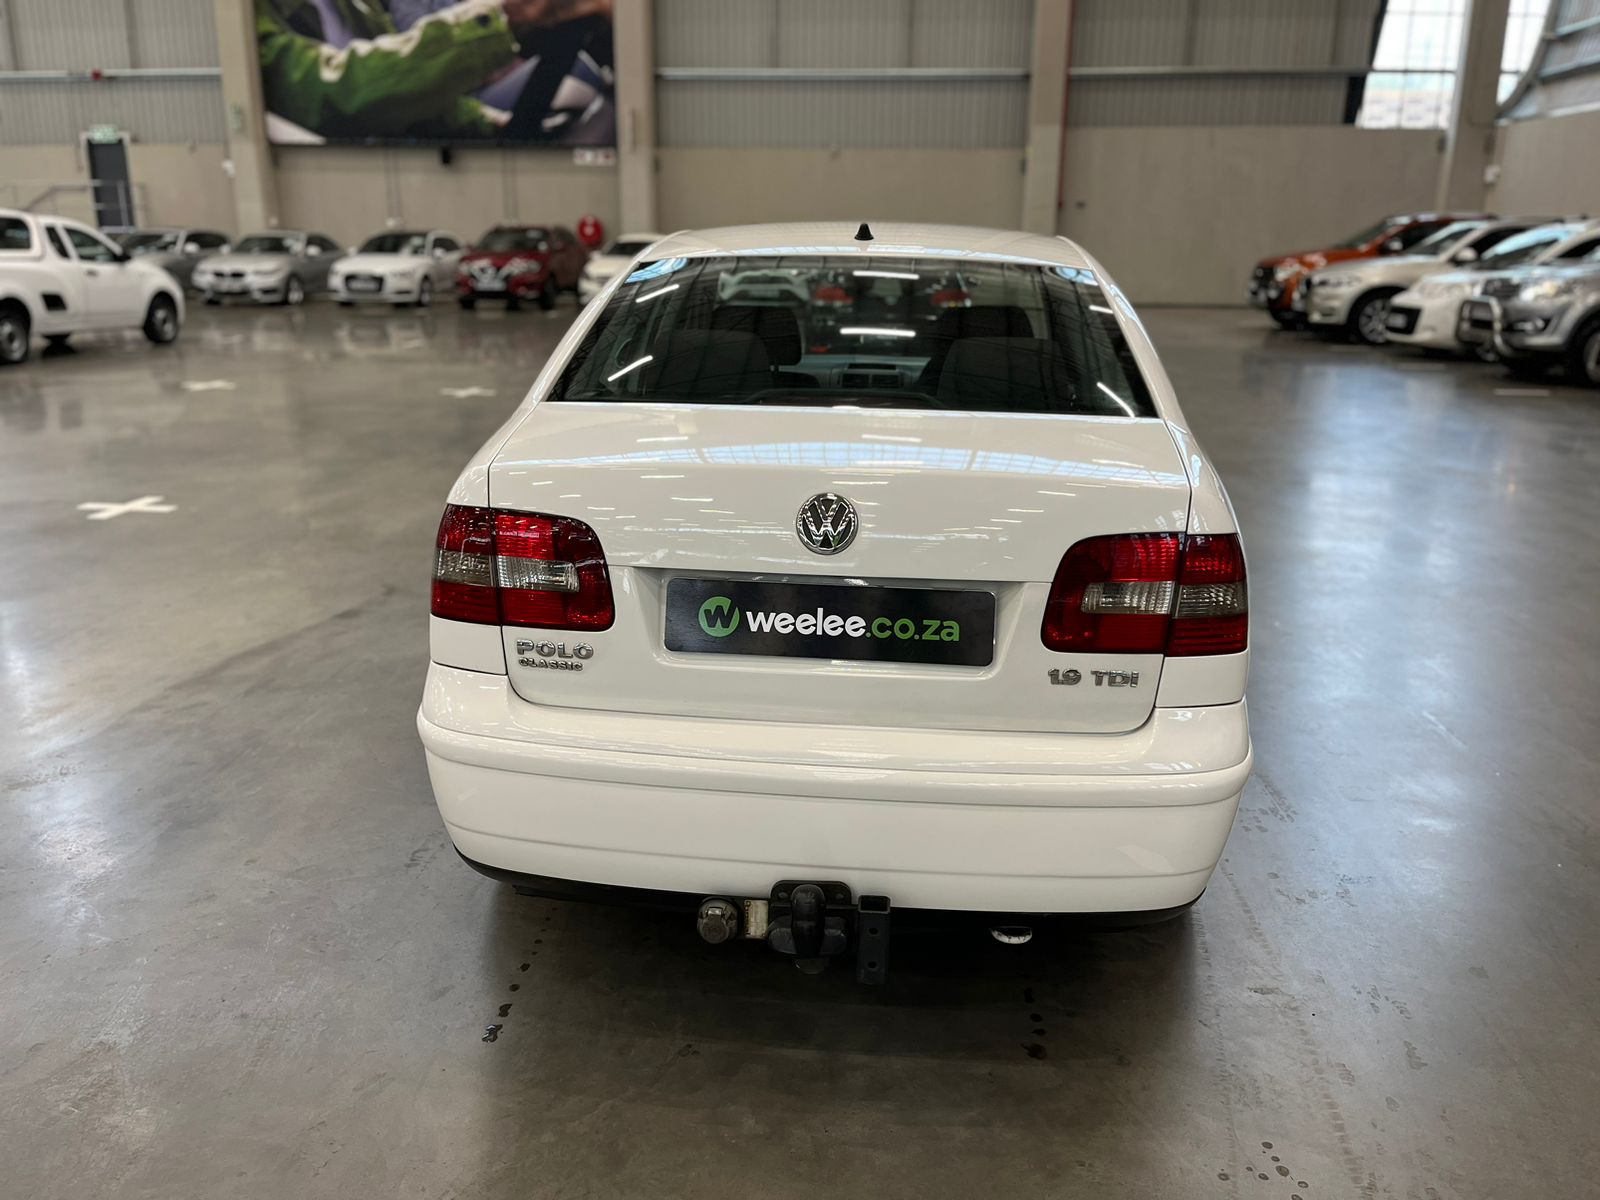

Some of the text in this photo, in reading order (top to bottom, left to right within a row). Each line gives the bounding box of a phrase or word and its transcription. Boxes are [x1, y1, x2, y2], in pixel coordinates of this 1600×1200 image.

[746, 607, 960, 641] weelee.co.za
[517, 639, 594, 660] POLO
[519, 657, 584, 672] CLASSIC
